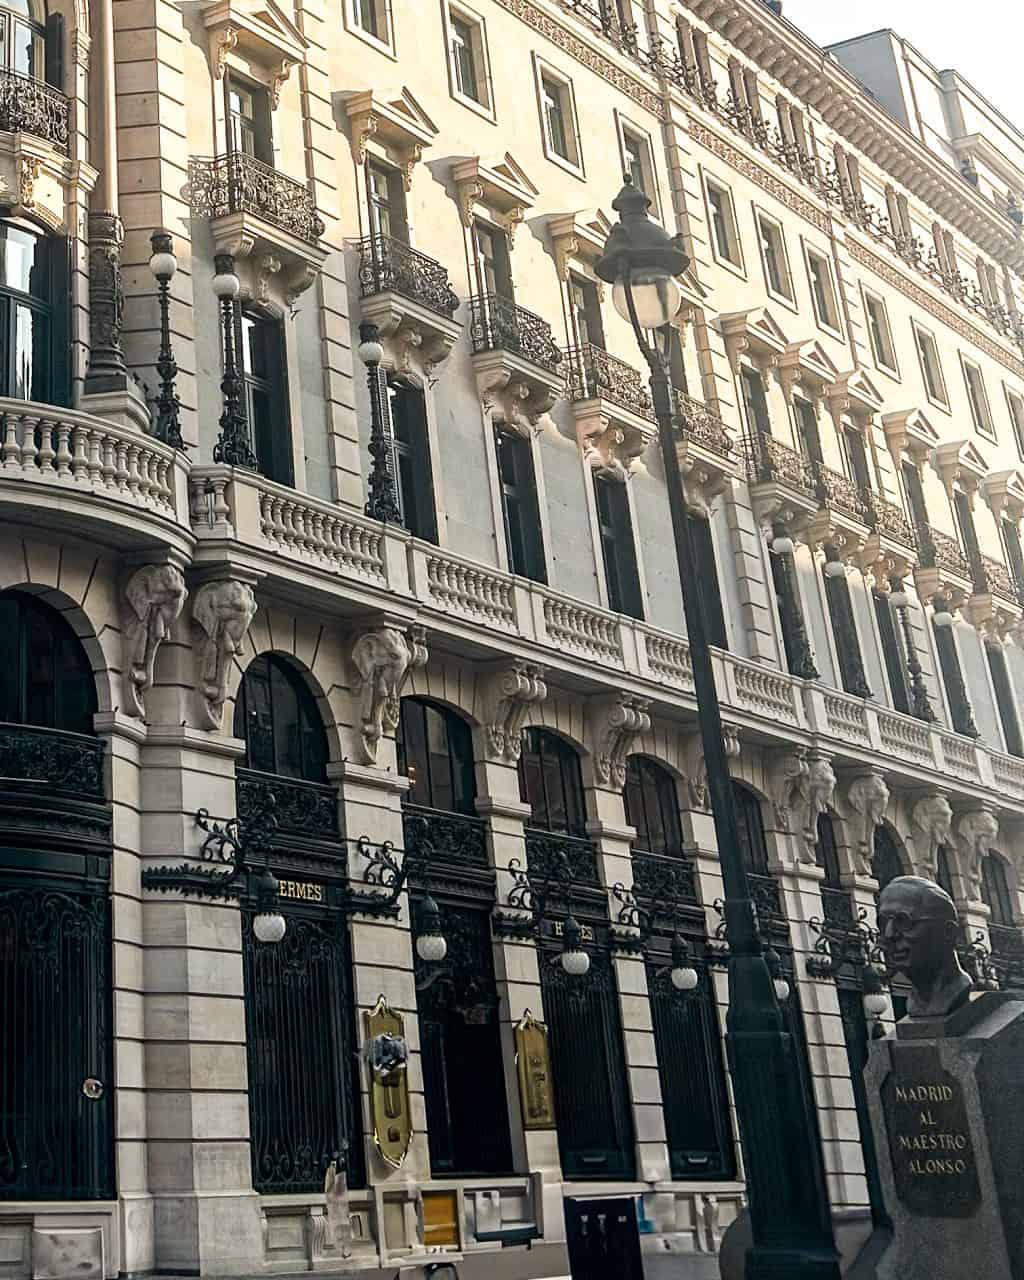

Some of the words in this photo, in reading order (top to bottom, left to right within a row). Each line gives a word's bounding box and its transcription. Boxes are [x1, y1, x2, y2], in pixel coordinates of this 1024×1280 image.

[896, 1086, 953, 1101] MADRID
[919, 1111, 936, 1125] AL
[899, 1134, 966, 1150] MAESTRO
